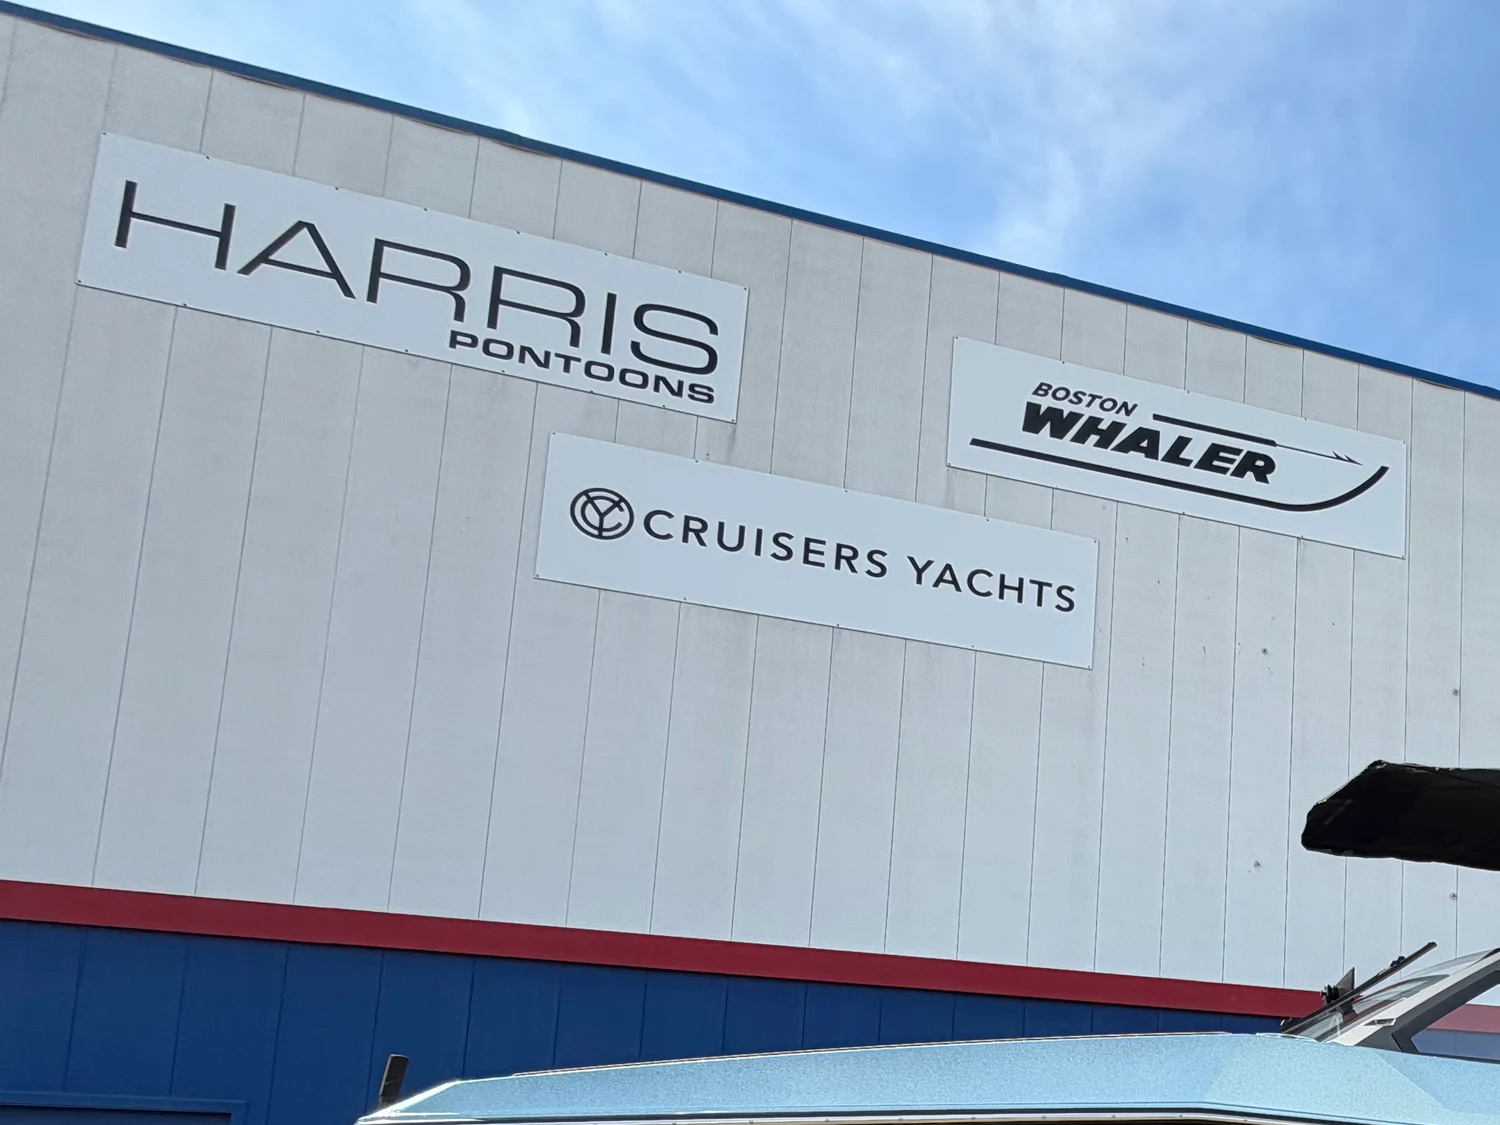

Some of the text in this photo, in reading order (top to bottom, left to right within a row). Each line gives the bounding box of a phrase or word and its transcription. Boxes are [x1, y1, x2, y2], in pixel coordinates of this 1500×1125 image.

[114, 179, 719, 375] HARRIS
[448, 329, 715, 404] PONTOONS
[1031, 382, 1138, 417] BOSTON
[1021, 401, 1276, 485] WHALER
[643, 509, 1075, 613] CRUISERS YACHTS
